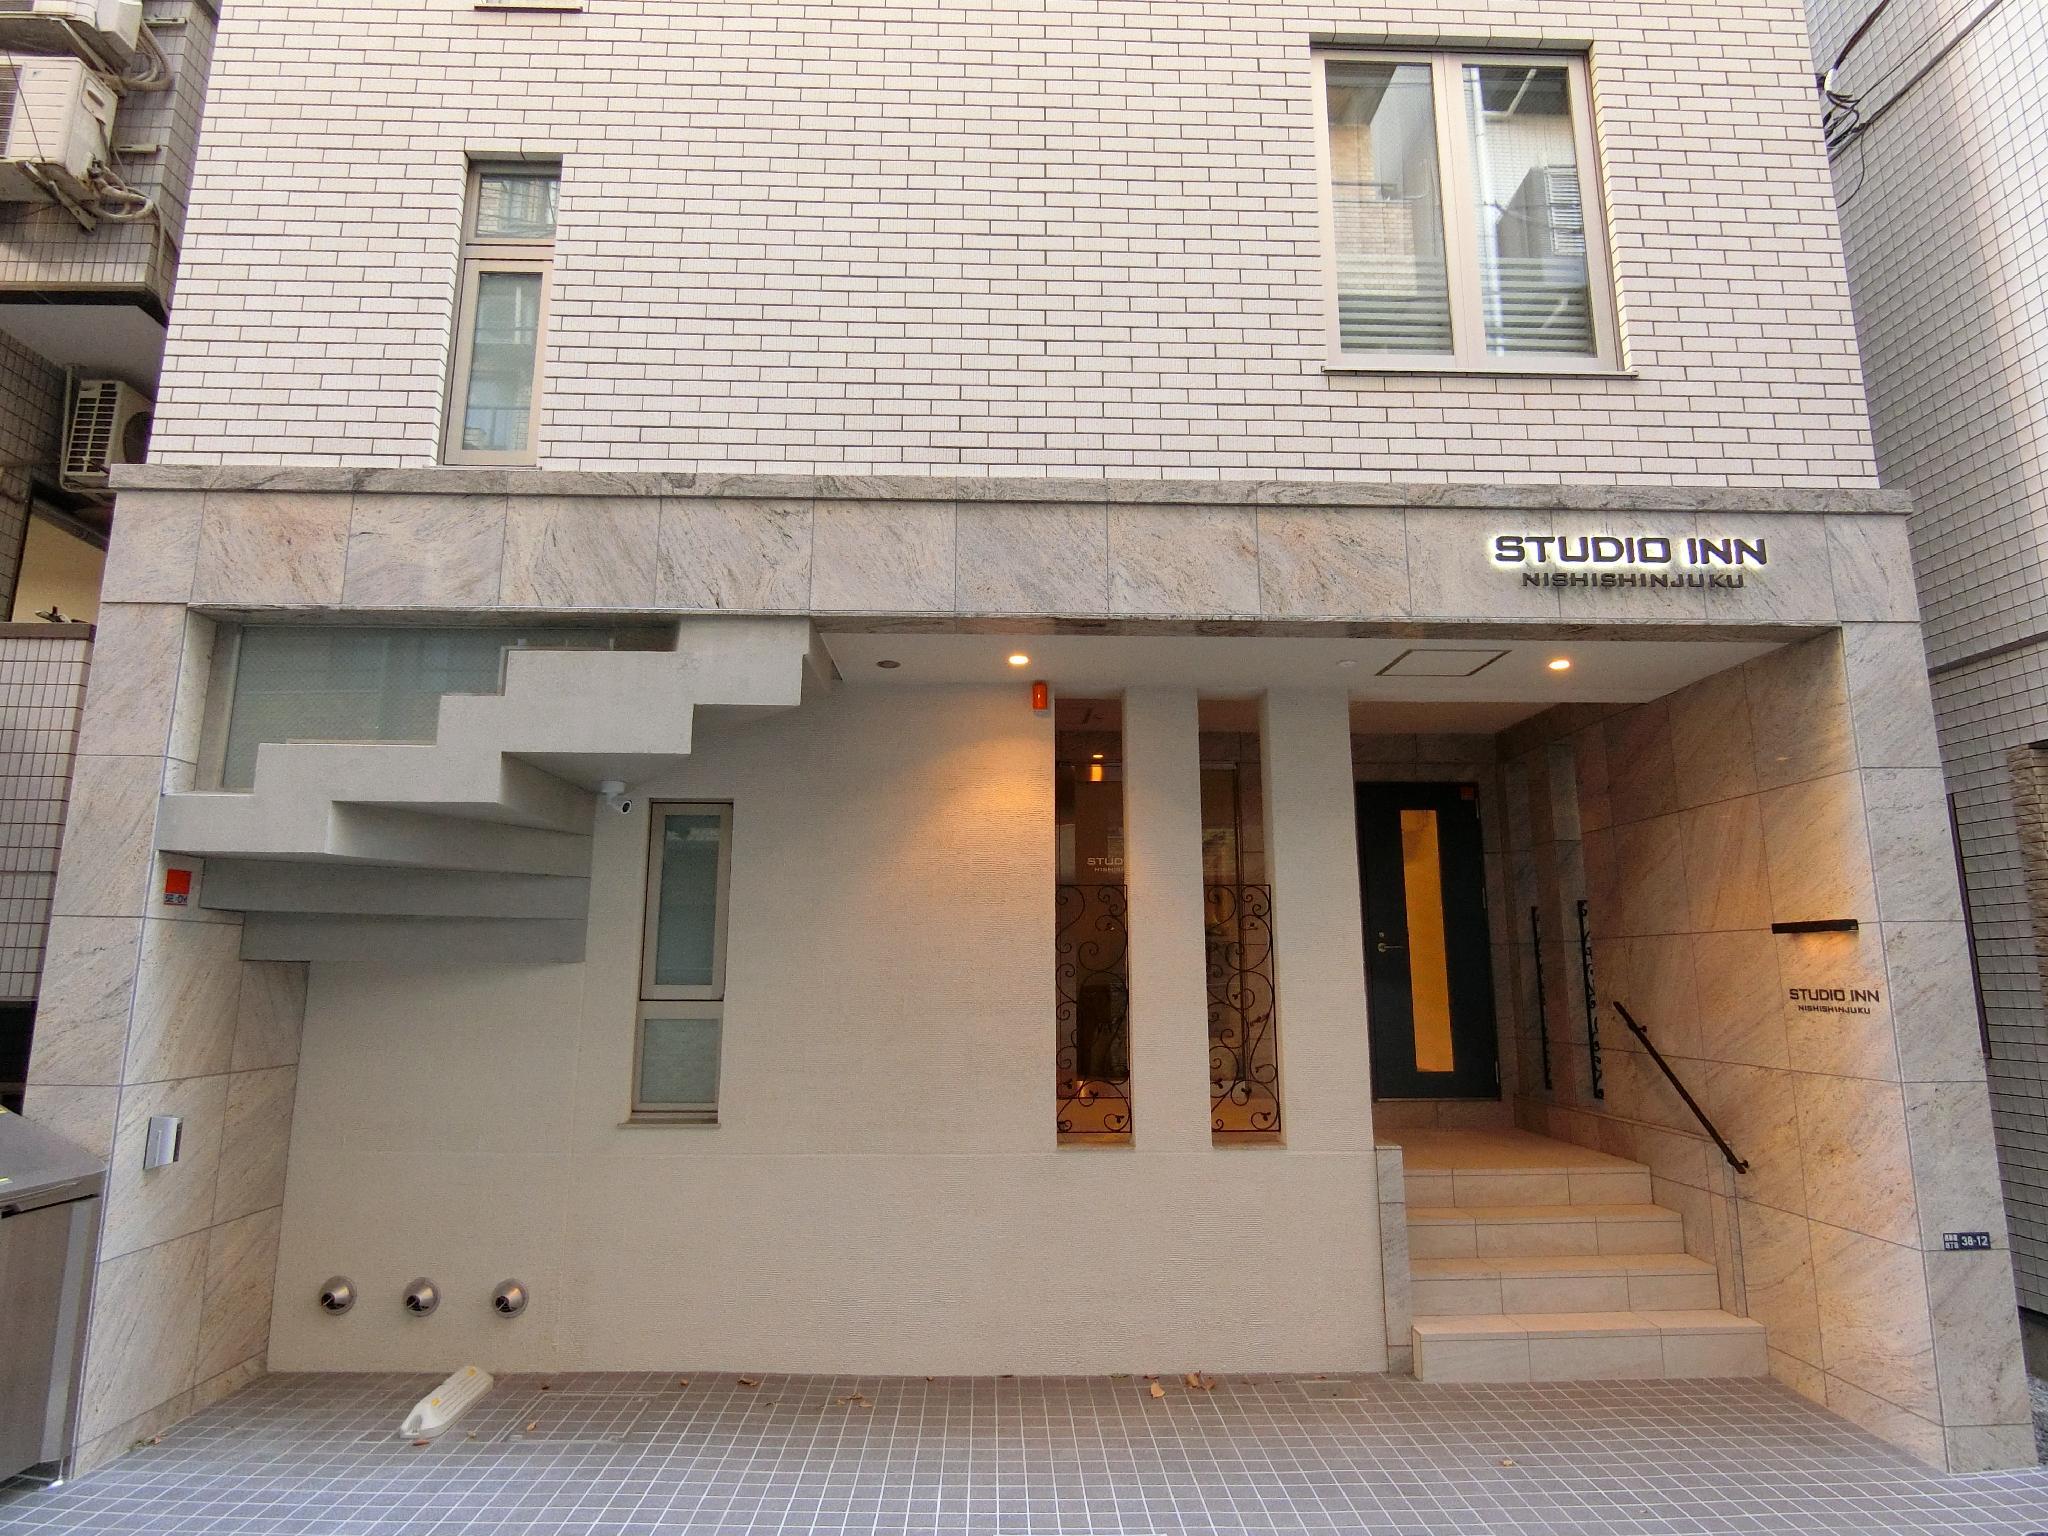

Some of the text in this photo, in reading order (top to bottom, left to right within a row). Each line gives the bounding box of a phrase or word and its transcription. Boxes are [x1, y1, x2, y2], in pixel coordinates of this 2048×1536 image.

[1495, 536, 1767, 565] STUDIO INN
[1522, 572, 1744, 588] NISHISHINJUKU
[1789, 989, 1879, 1002] STUDIO INN
[1798, 1005, 1870, 1014] NISHISHINJUKU
[1961, 1235, 1988, 1246] 38-12
